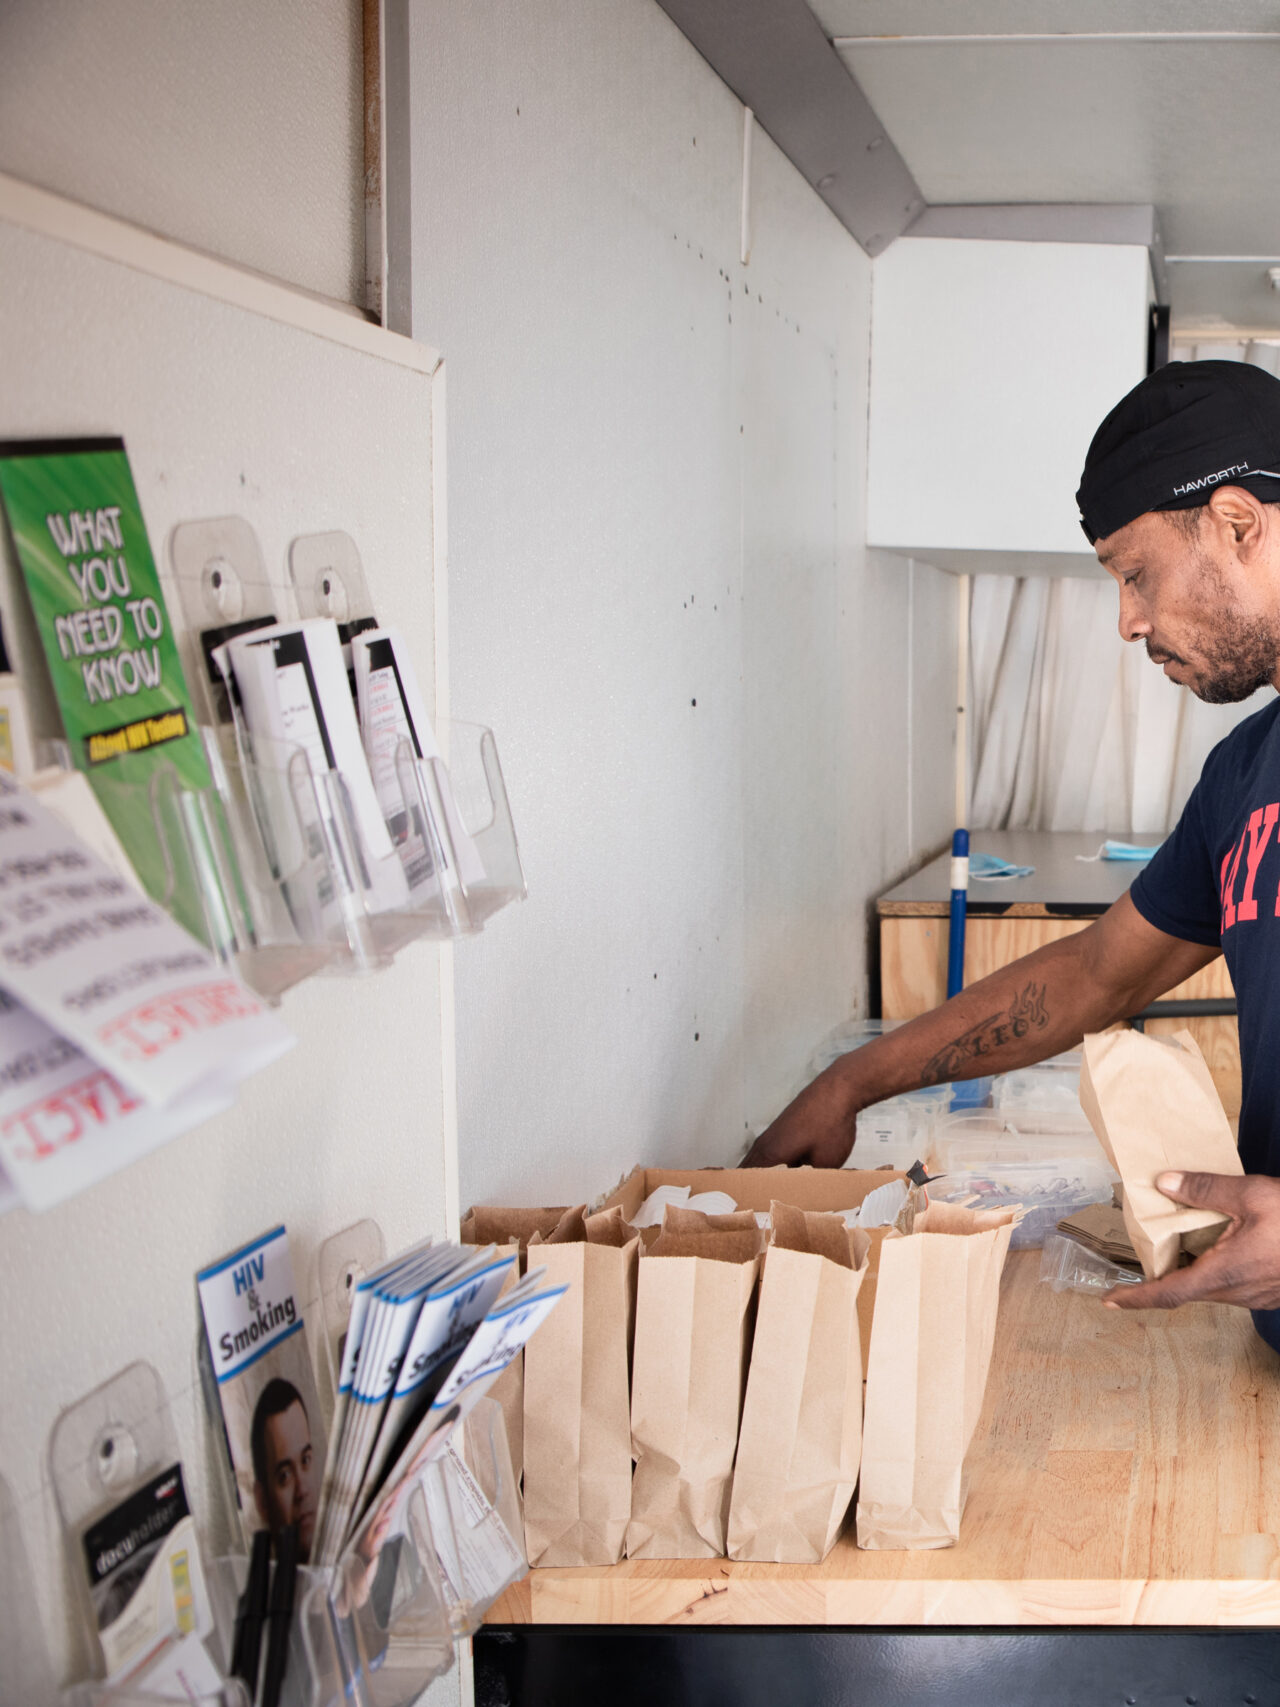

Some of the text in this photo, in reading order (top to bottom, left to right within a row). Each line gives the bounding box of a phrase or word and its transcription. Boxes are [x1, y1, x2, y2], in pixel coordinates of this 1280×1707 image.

[1173, 461, 1249, 496] HAWORTH
[46, 506, 124, 557] WHAT
[68, 554, 131, 604] YOU
[54, 597, 163, 661] NEED TO
[81, 645, 161, 705] KNOW
[126, 721, 150, 751] HIV
[145, 713, 186, 743] Testing
[232, 1253, 264, 1297] HIV
[247, 1288, 261, 1312] &
[219, 1295, 297, 1362] Smoking
